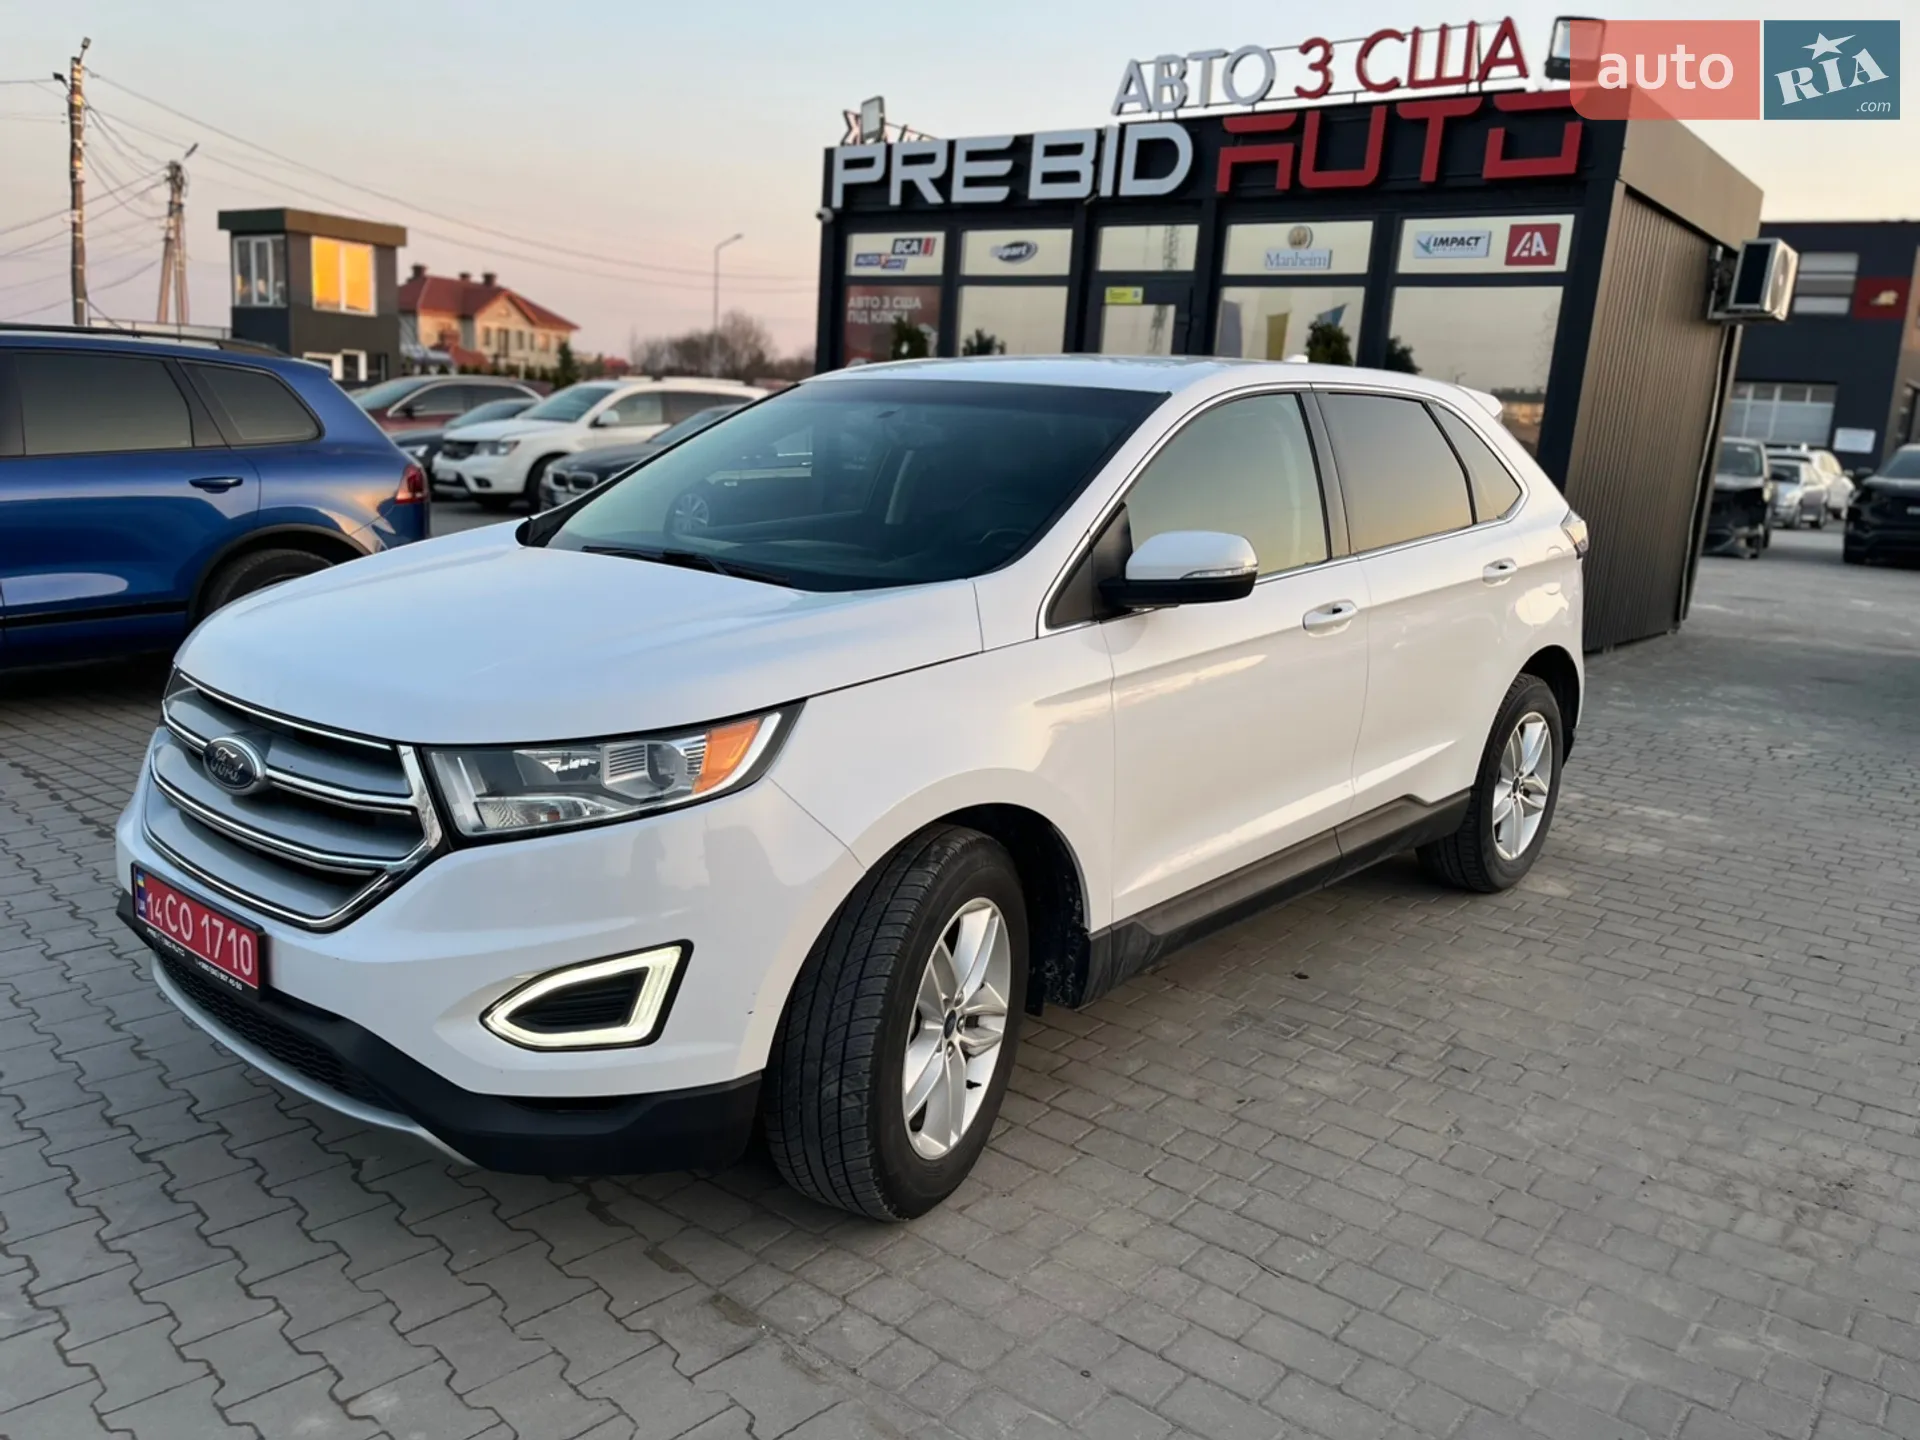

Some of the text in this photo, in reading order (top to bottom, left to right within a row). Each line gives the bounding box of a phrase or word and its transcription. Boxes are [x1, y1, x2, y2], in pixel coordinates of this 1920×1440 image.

[1111, 44, 1276, 116] АВТО
[1356, 16, 1529, 93] США
[1216, 90, 1586, 194] AUTO
[1265, 251, 1327, 267] Manheim
[1432, 236, 1481, 247] IMPACT
[201, 913, 253, 976] 1710
